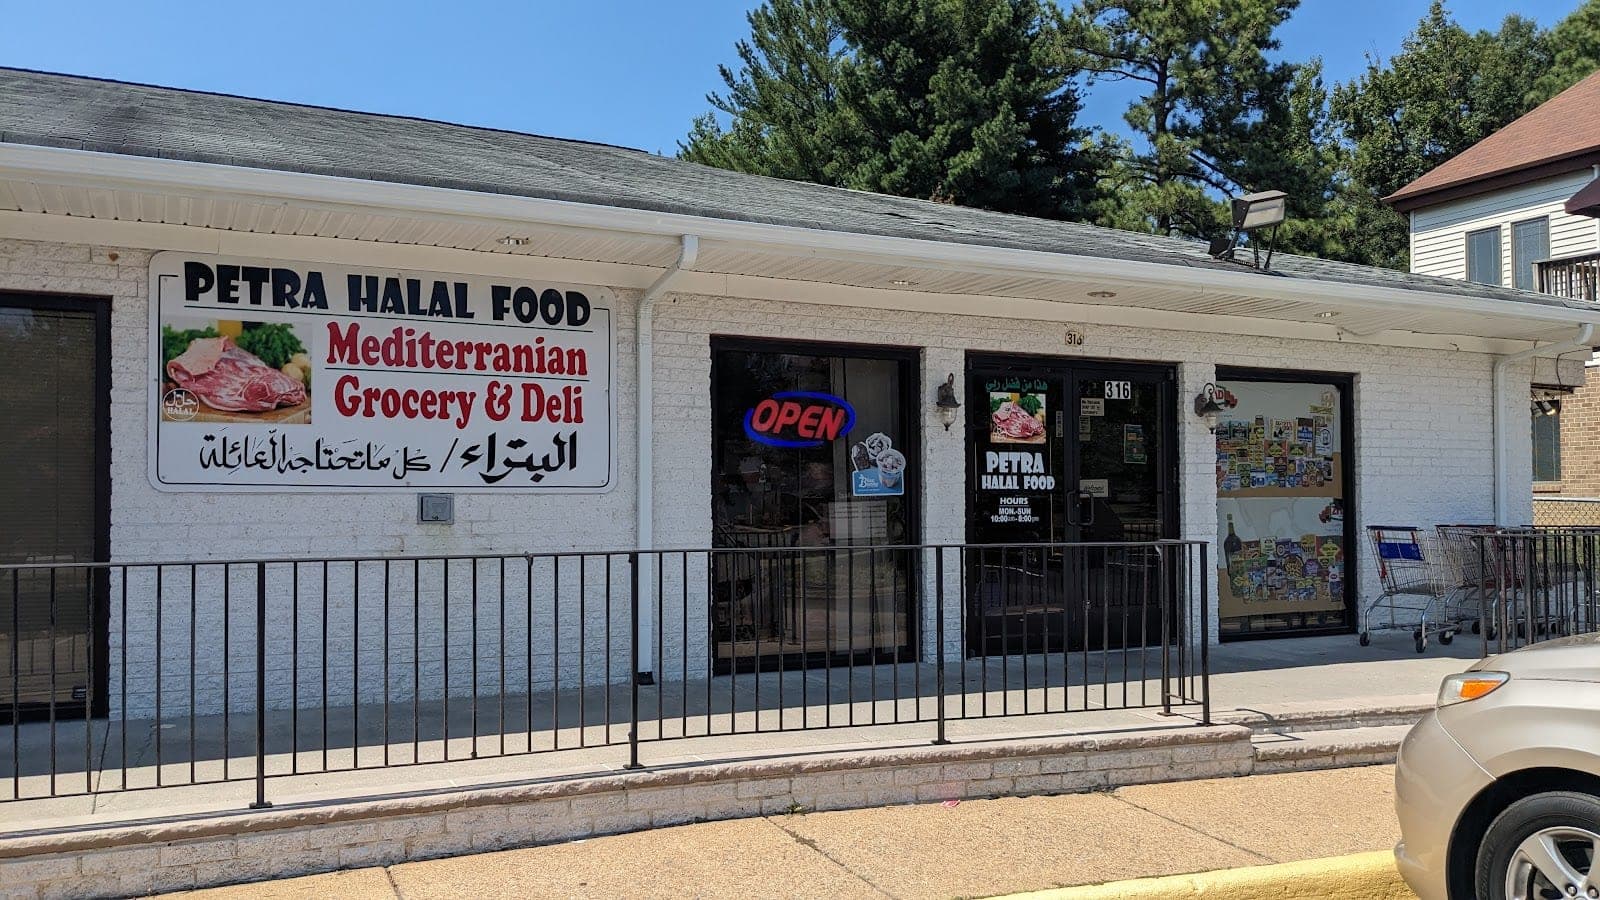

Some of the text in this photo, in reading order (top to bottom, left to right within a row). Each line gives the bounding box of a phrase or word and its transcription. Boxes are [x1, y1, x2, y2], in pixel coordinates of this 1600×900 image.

[184, 261, 591, 326] PETRA HALAL FOOD
[326, 321, 587, 376] Mediterranian
[334, 374, 584, 429] Grocery & Deli
[1106, 382, 1130, 399] 316
[167, 407, 193, 415] HALAL
[751, 398, 845, 441] OPEN
[460, 431, 577, 483] البتراء
[985, 451, 1045, 474] PETRA
[981, 474, 1056, 490] HALAL FOOD
[999, 497, 1029, 505] HOURS
